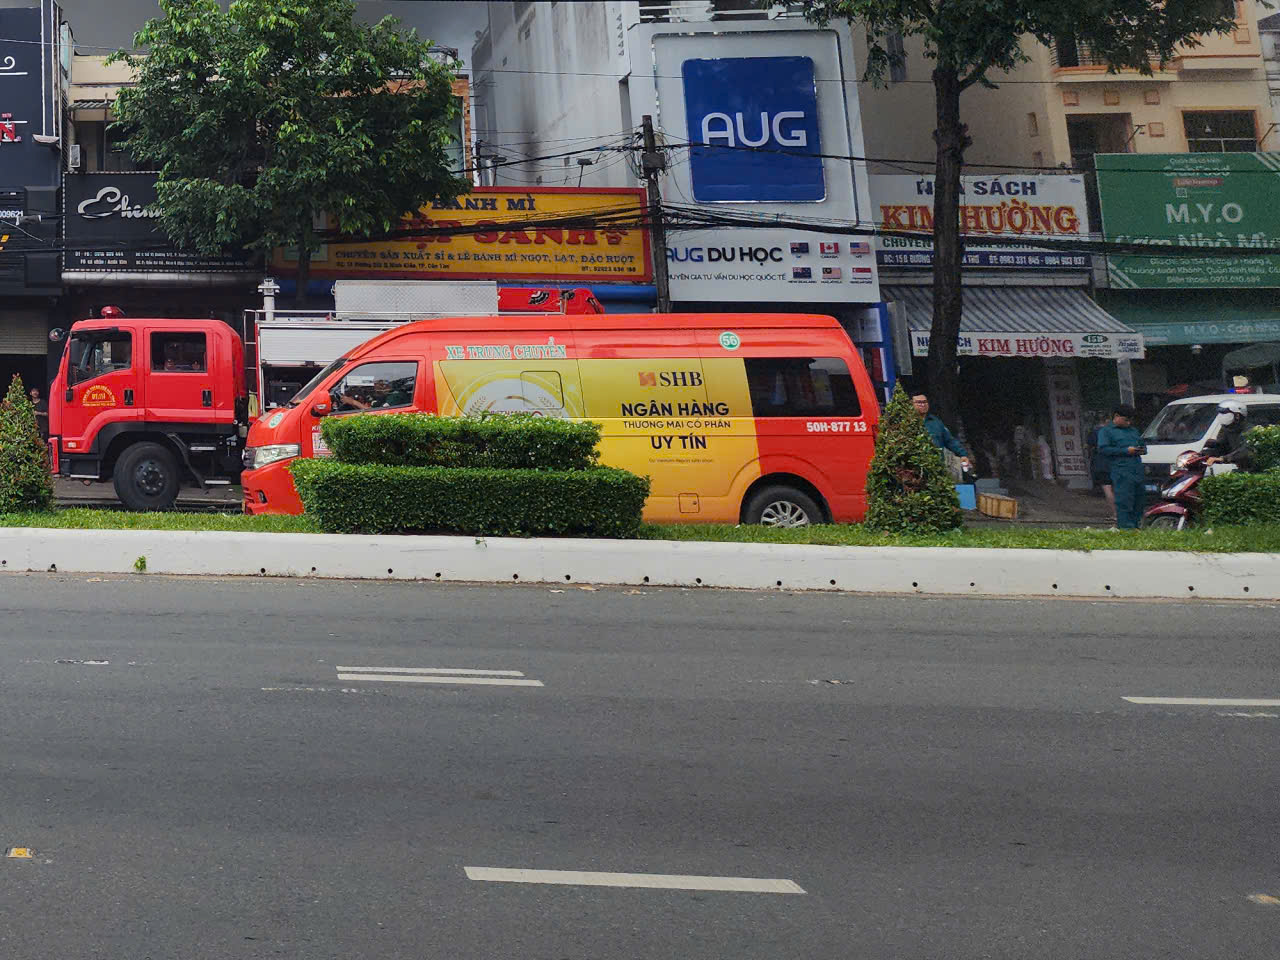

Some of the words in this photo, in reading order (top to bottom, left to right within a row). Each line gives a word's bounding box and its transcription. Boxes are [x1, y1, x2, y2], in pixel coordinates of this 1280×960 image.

[702, 111, 807, 147] AUG
[974, 178, 1037, 196] SÁCH
[506, 194, 536, 210] MÌ
[960, 198, 1080, 234] HƯỜNG
[1166, 202, 1244, 224] M.Y.O
[505, 251, 518, 262] MÌ
[708, 247, 736, 262] DU
[740, 247, 784, 266] HỌC
[739, 274, 754, 282] HỌC
[722, 334, 738, 346] 56
[977, 338, 1012, 354] KIM
[1016, 335, 1074, 354] HƯỜNG
[445, 346, 466, 360] XE
[467, 345, 512, 359] TRUNG
[659, 372, 703, 387] SHB
[622, 400, 673, 416] NGÂN
[677, 398, 730, 416] HÀNG
[623, 420, 670, 429] THƯƠNG
[672, 420, 685, 430] MẠI
[806, 422, 850, 432] 50H-877
[852, 422, 867, 432] 13
[650, 436, 672, 450] UY
[678, 432, 708, 450] TÍN
